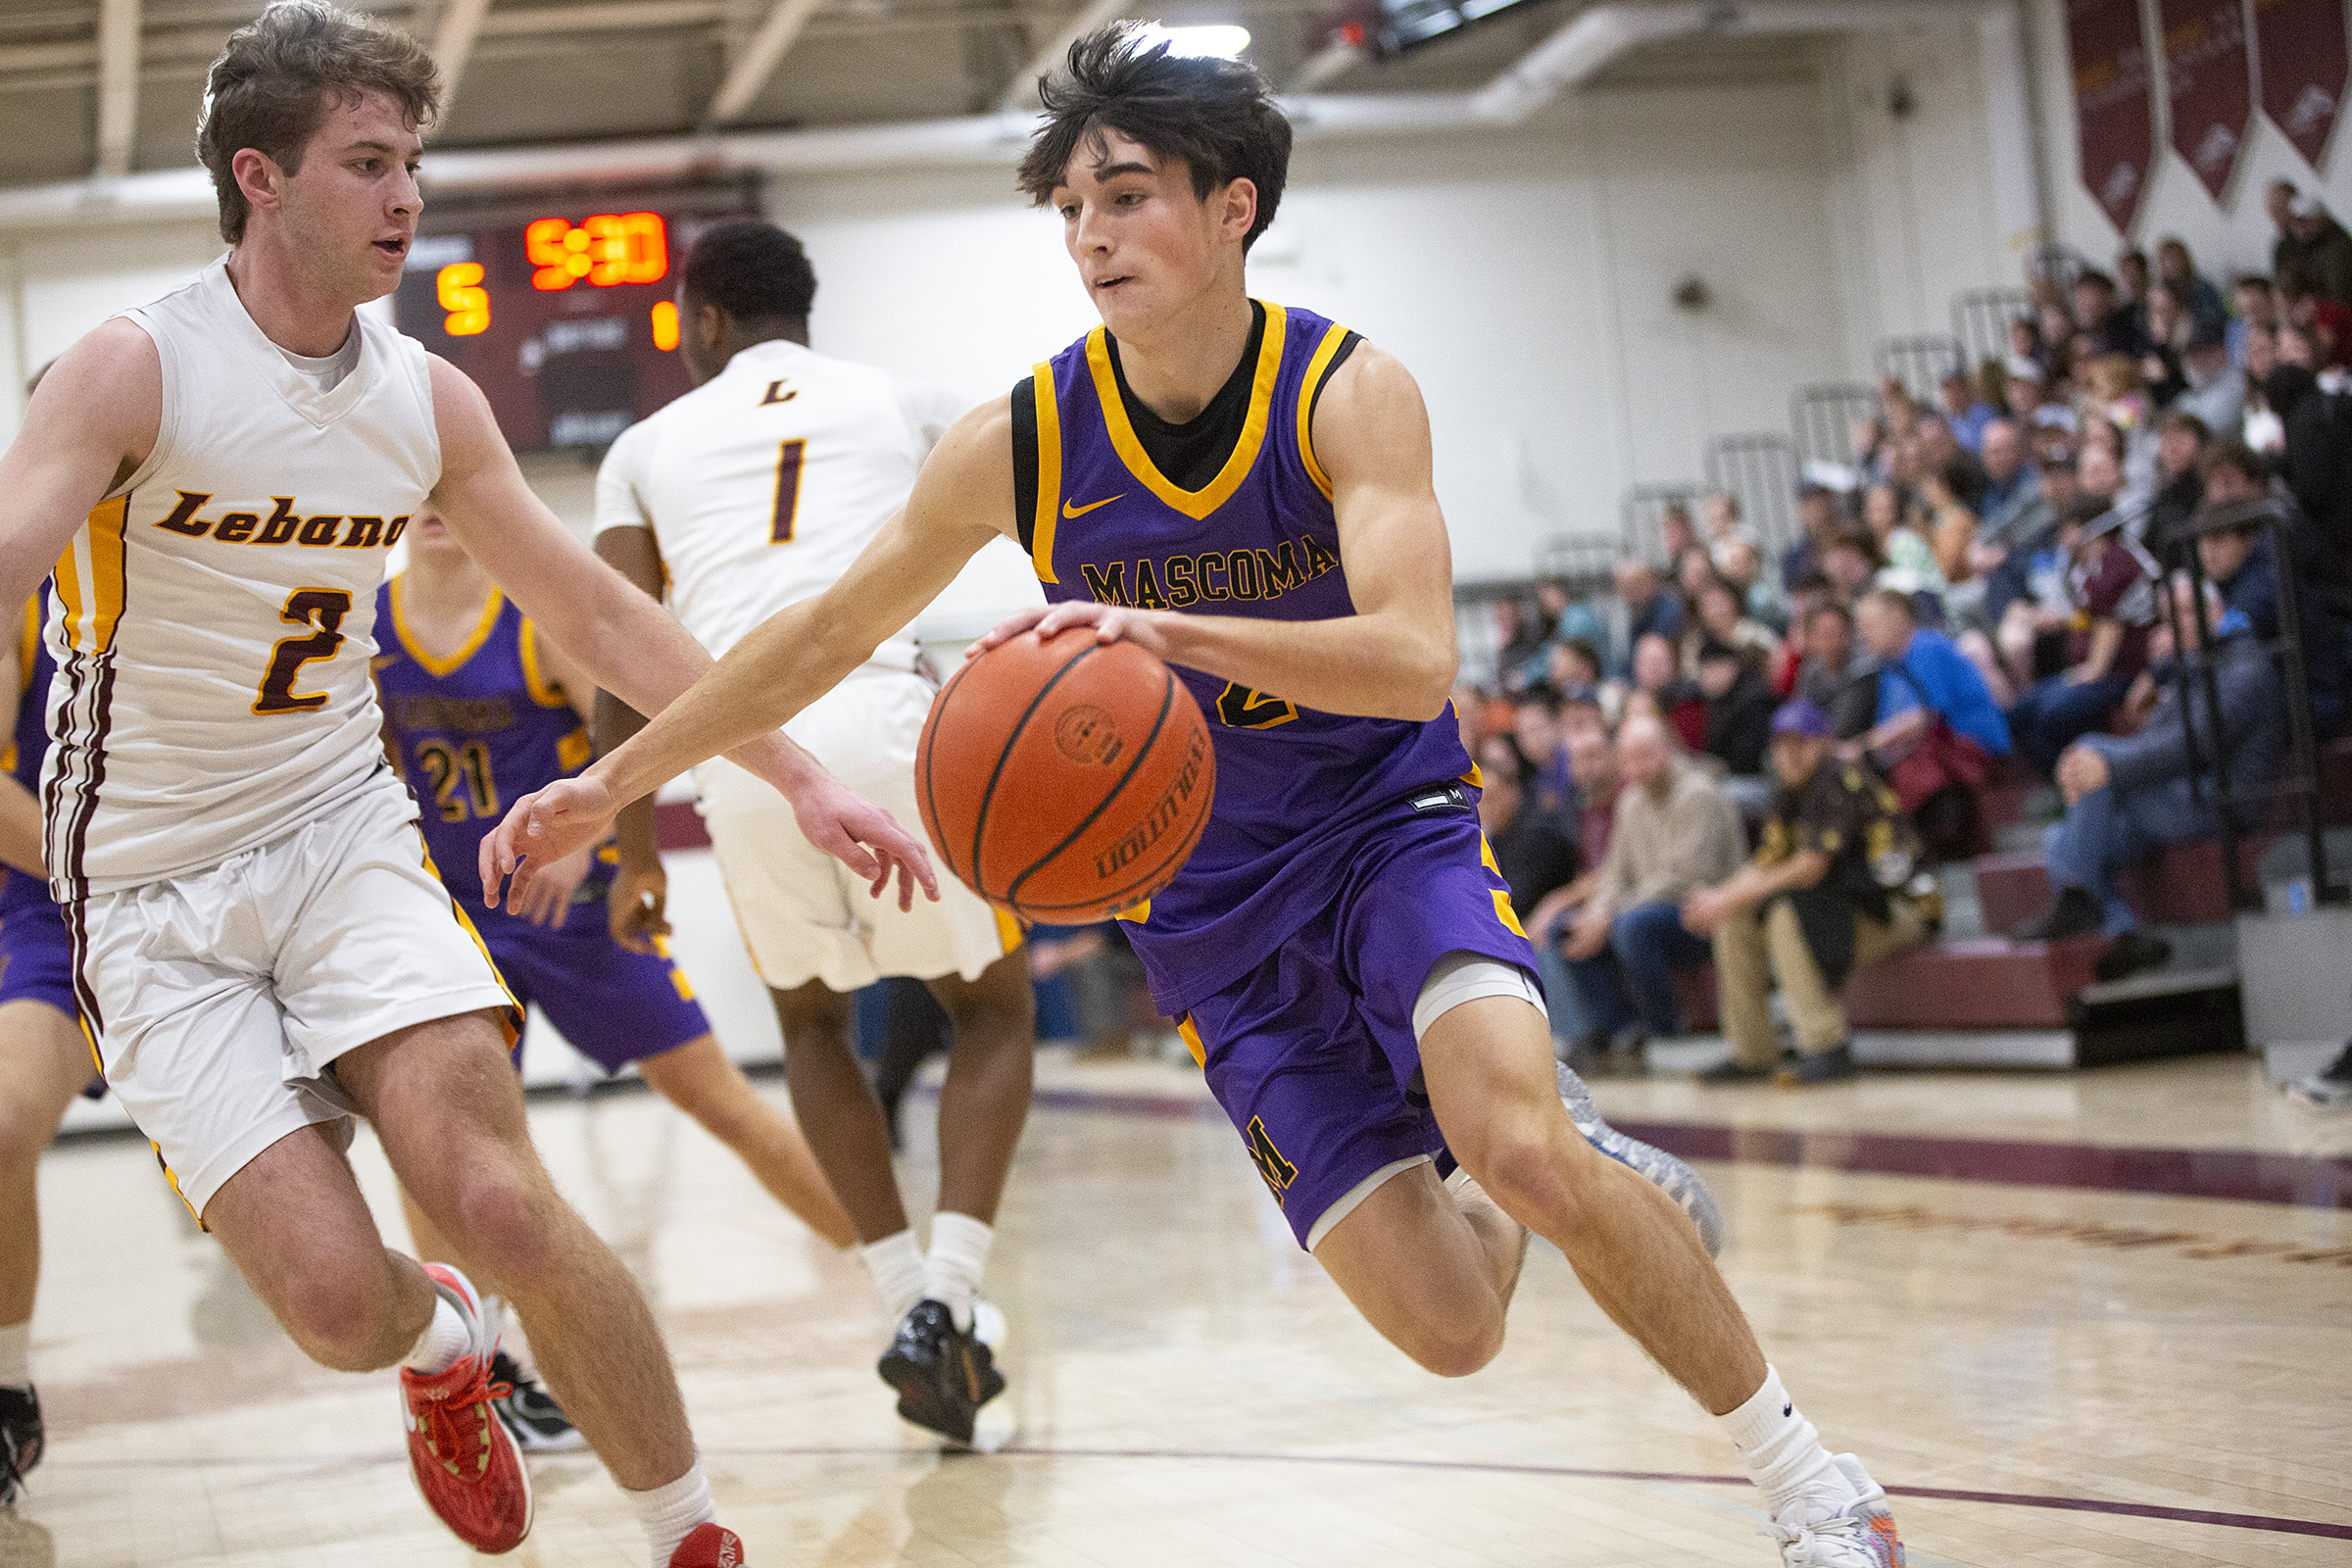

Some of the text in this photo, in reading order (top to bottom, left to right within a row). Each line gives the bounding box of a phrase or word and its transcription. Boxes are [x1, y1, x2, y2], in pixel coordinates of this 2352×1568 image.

[524, 211, 668, 291] 5:30
[436, 262, 490, 336] 5
[756, 378, 798, 408] L
[768, 438, 807, 546] 1
[1081, 534, 1339, 611] MASCOMA
[251, 586, 352, 716] 2
[416, 738, 500, 823] 21
[1247, 1114, 1298, 1209] M
